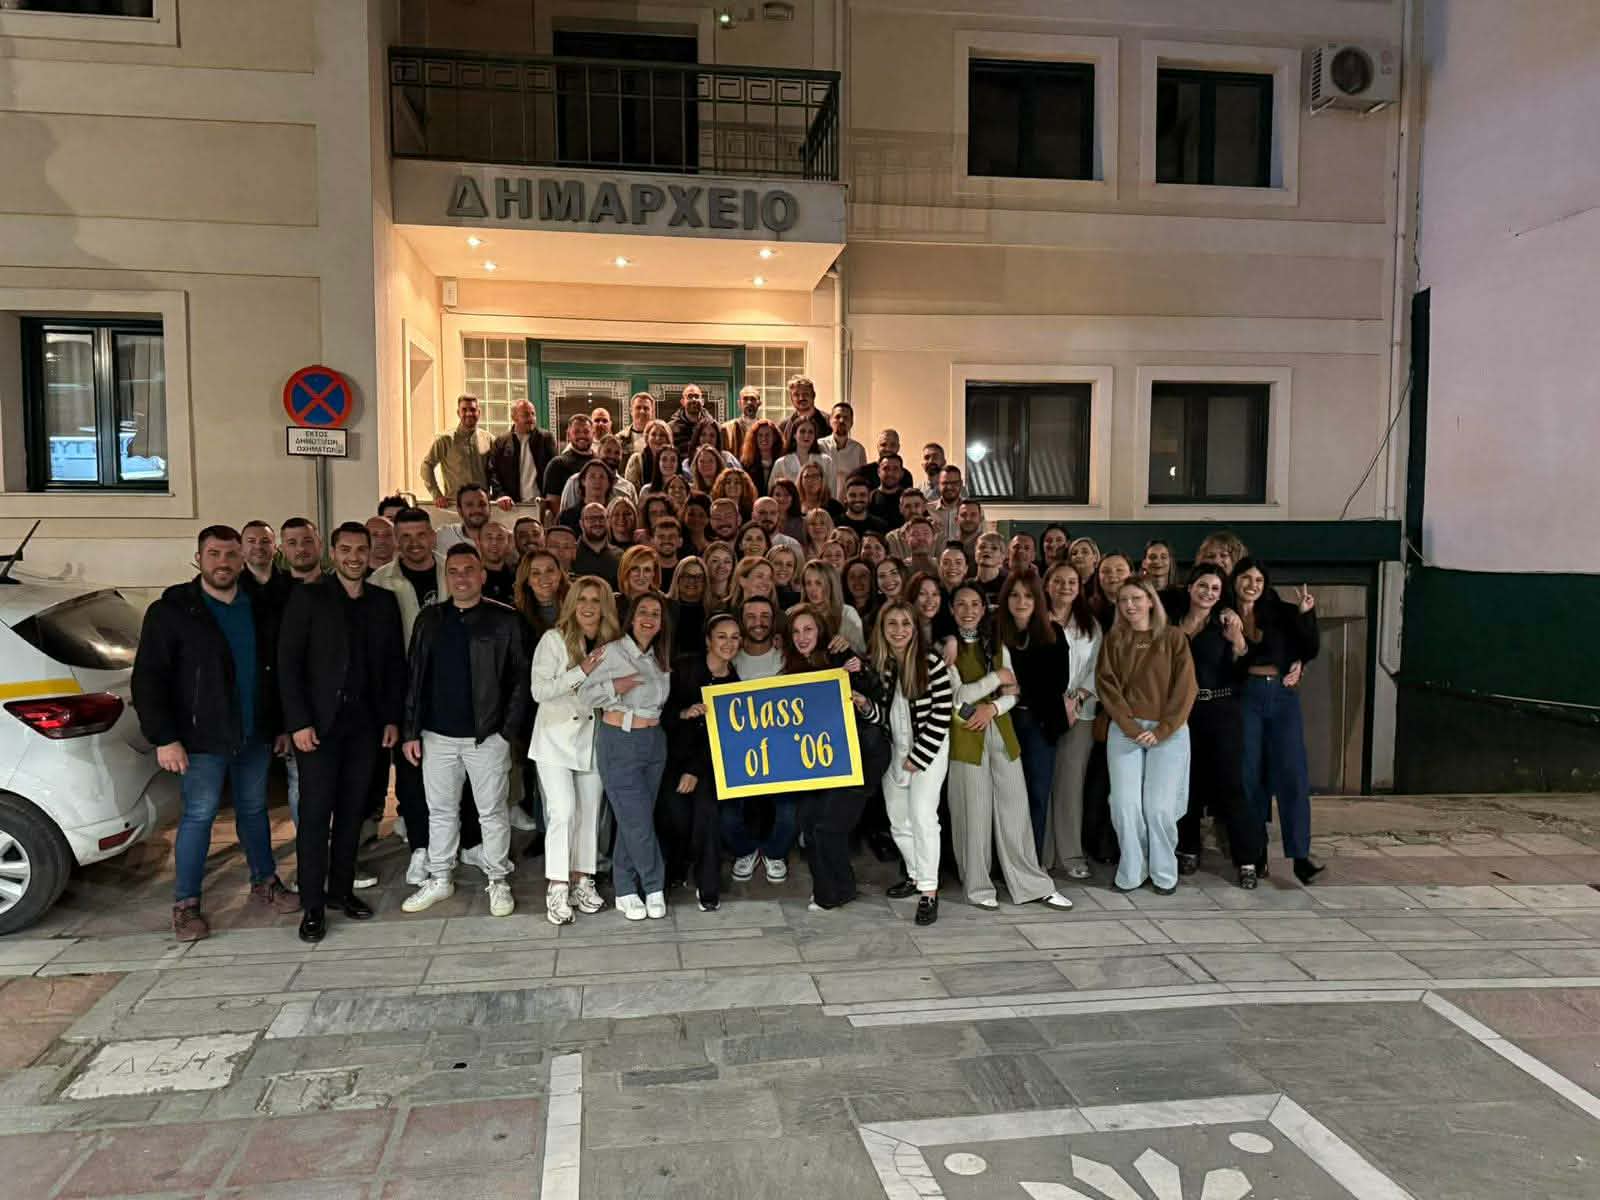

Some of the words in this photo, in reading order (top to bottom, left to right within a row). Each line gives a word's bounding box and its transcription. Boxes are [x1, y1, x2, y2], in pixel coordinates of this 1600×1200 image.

[447, 175, 799, 233] ΔΗΜΑΡΧΕΙΟ
[729, 695, 805, 732] Class
[744, 736, 770, 777] of
